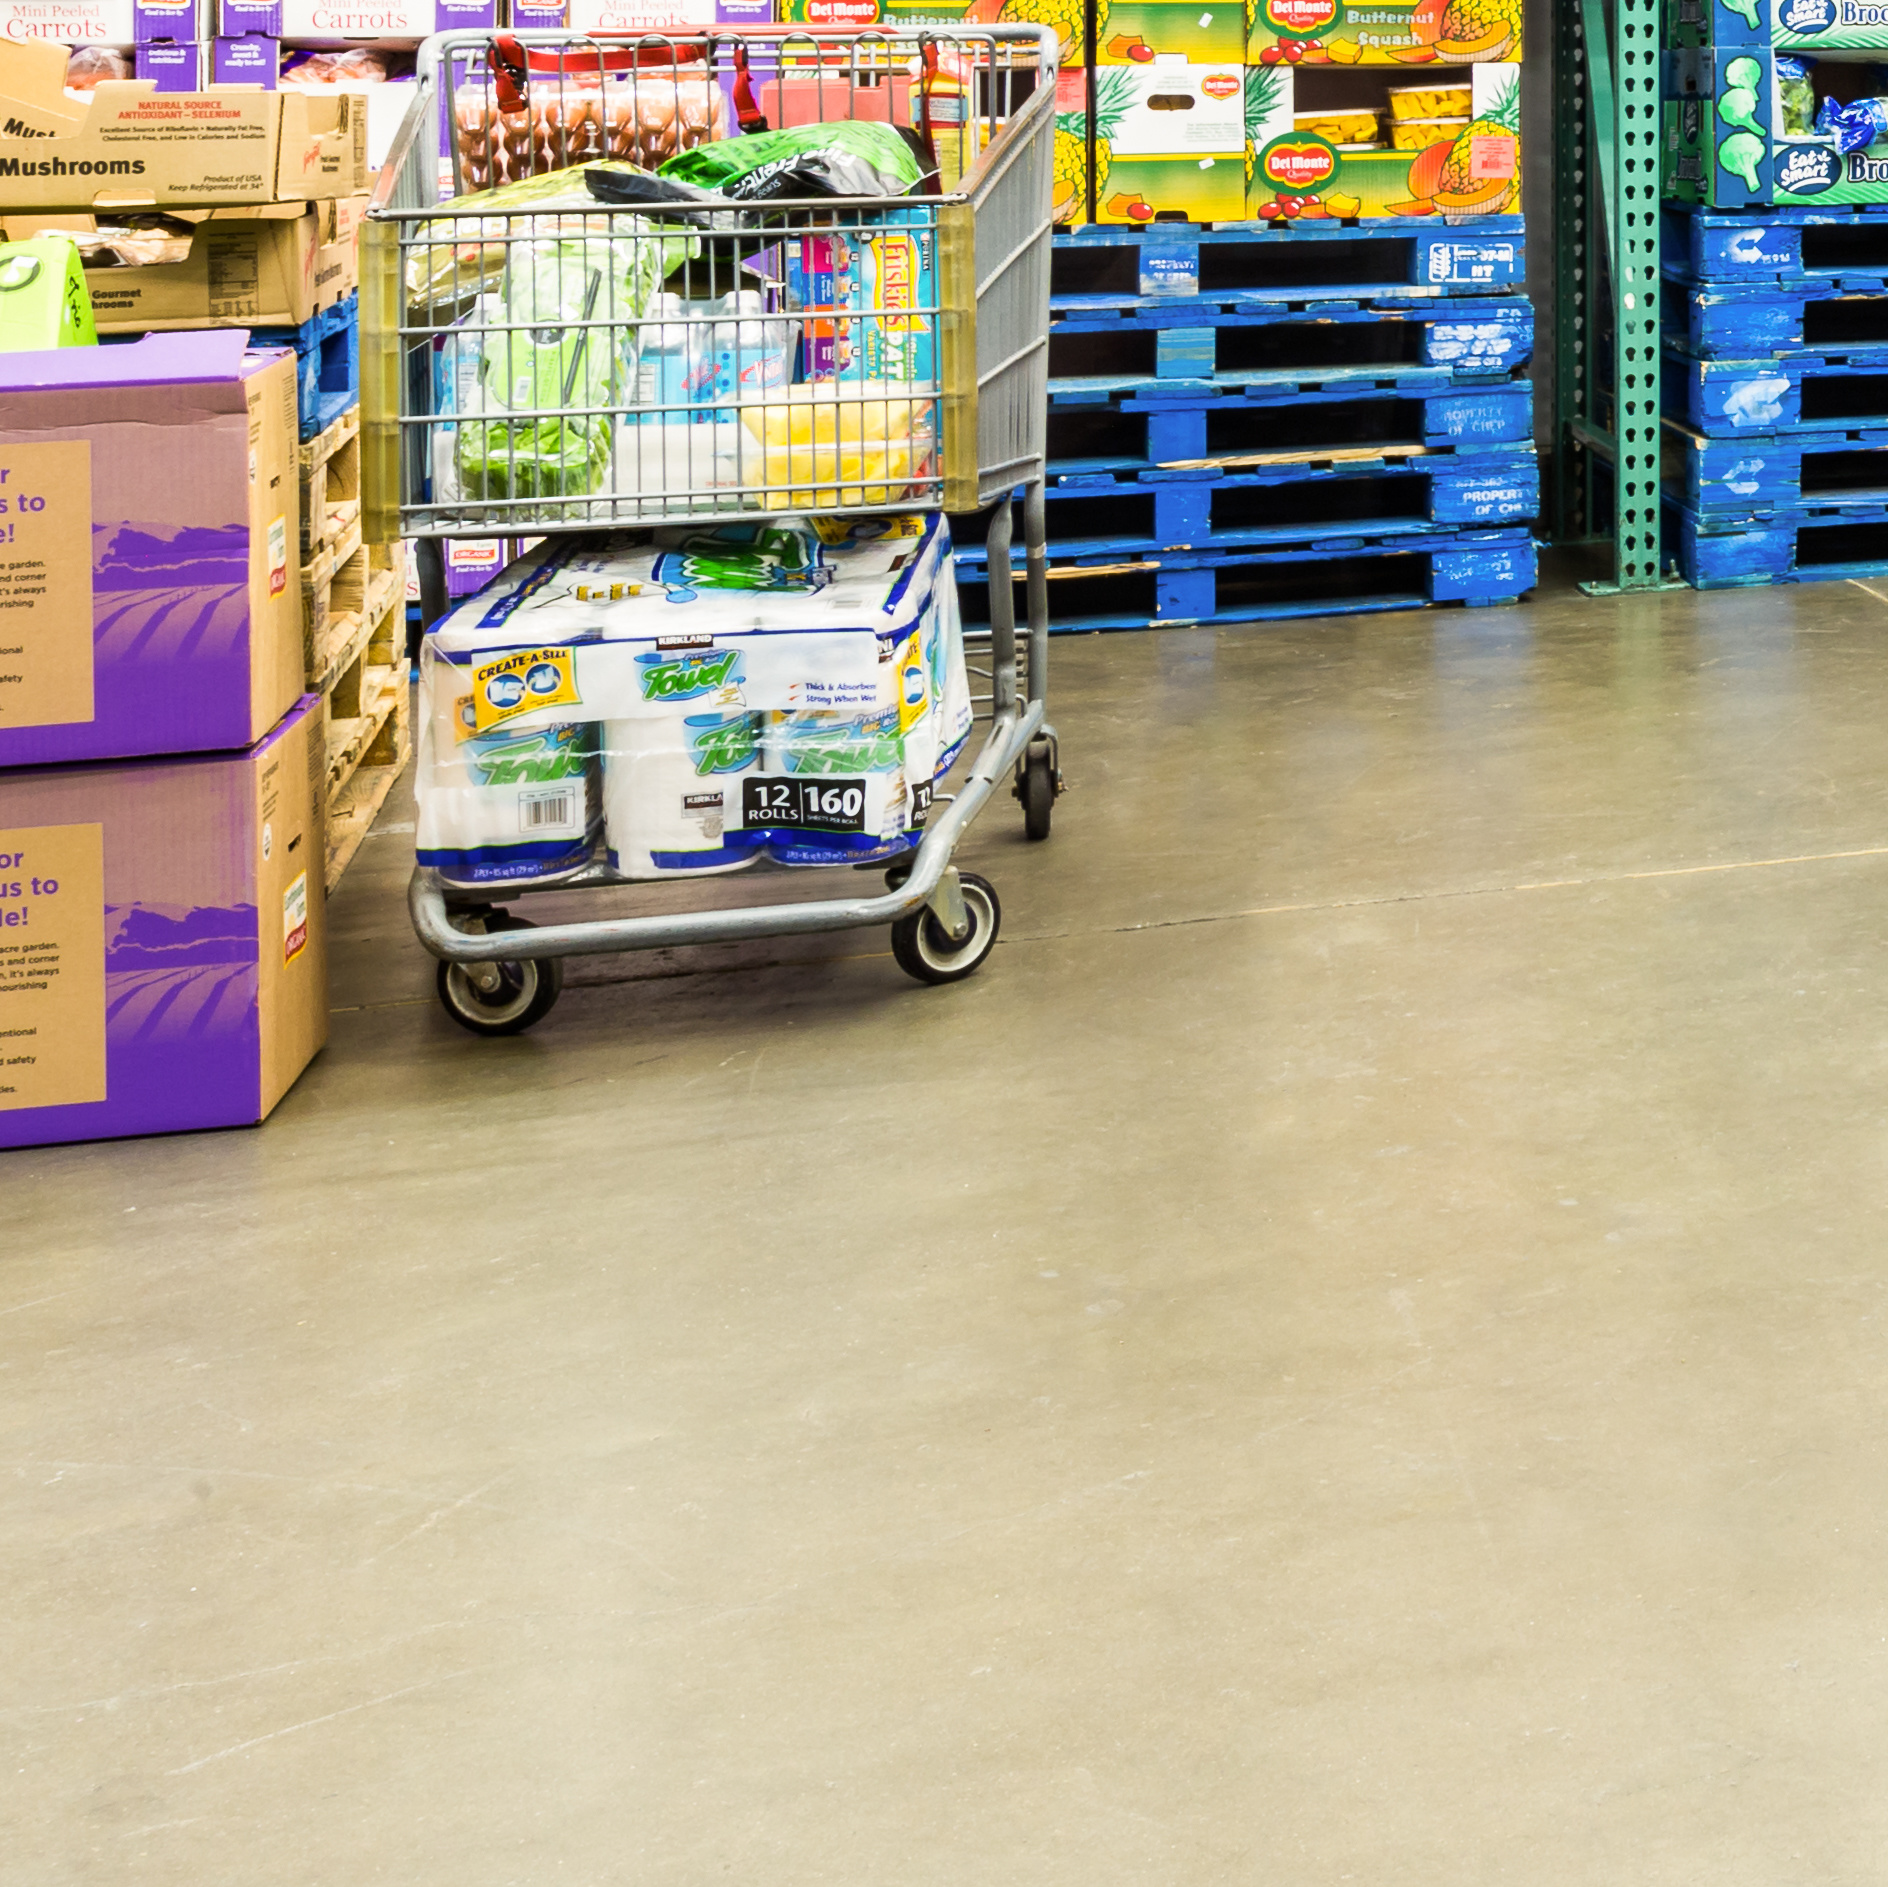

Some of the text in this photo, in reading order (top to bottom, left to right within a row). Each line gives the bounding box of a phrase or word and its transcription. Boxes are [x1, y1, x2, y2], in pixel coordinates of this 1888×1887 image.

[1272, 0, 1332, 18] Del Monte
[1347, 9, 1434, 26] Butternut
[312, 8, 409, 32] Carrots
[1358, 31, 1424, 50] Squash
[138, 101, 221, 110] NATURAL SOURCE
[118, 111, 241, 120] ANTIOXIDANT SELENIUM
[0, 158, 146, 176] Mushrooms
[1786, 148, 1816, 169] Eat
[203, 175, 233, 184] Product
[1779, 166, 1831, 184] Smart
[657, 633, 713, 648] KIRKLAND
[478, 649, 569, 680] CREATE-A-SIZE
[644, 651, 734, 701] Towel
[806, 692, 877, 705] Strong When Wet
[754, 785, 791, 809] 12
[805, 787, 864, 817] 160
[748, 808, 799, 821] ROLLS
